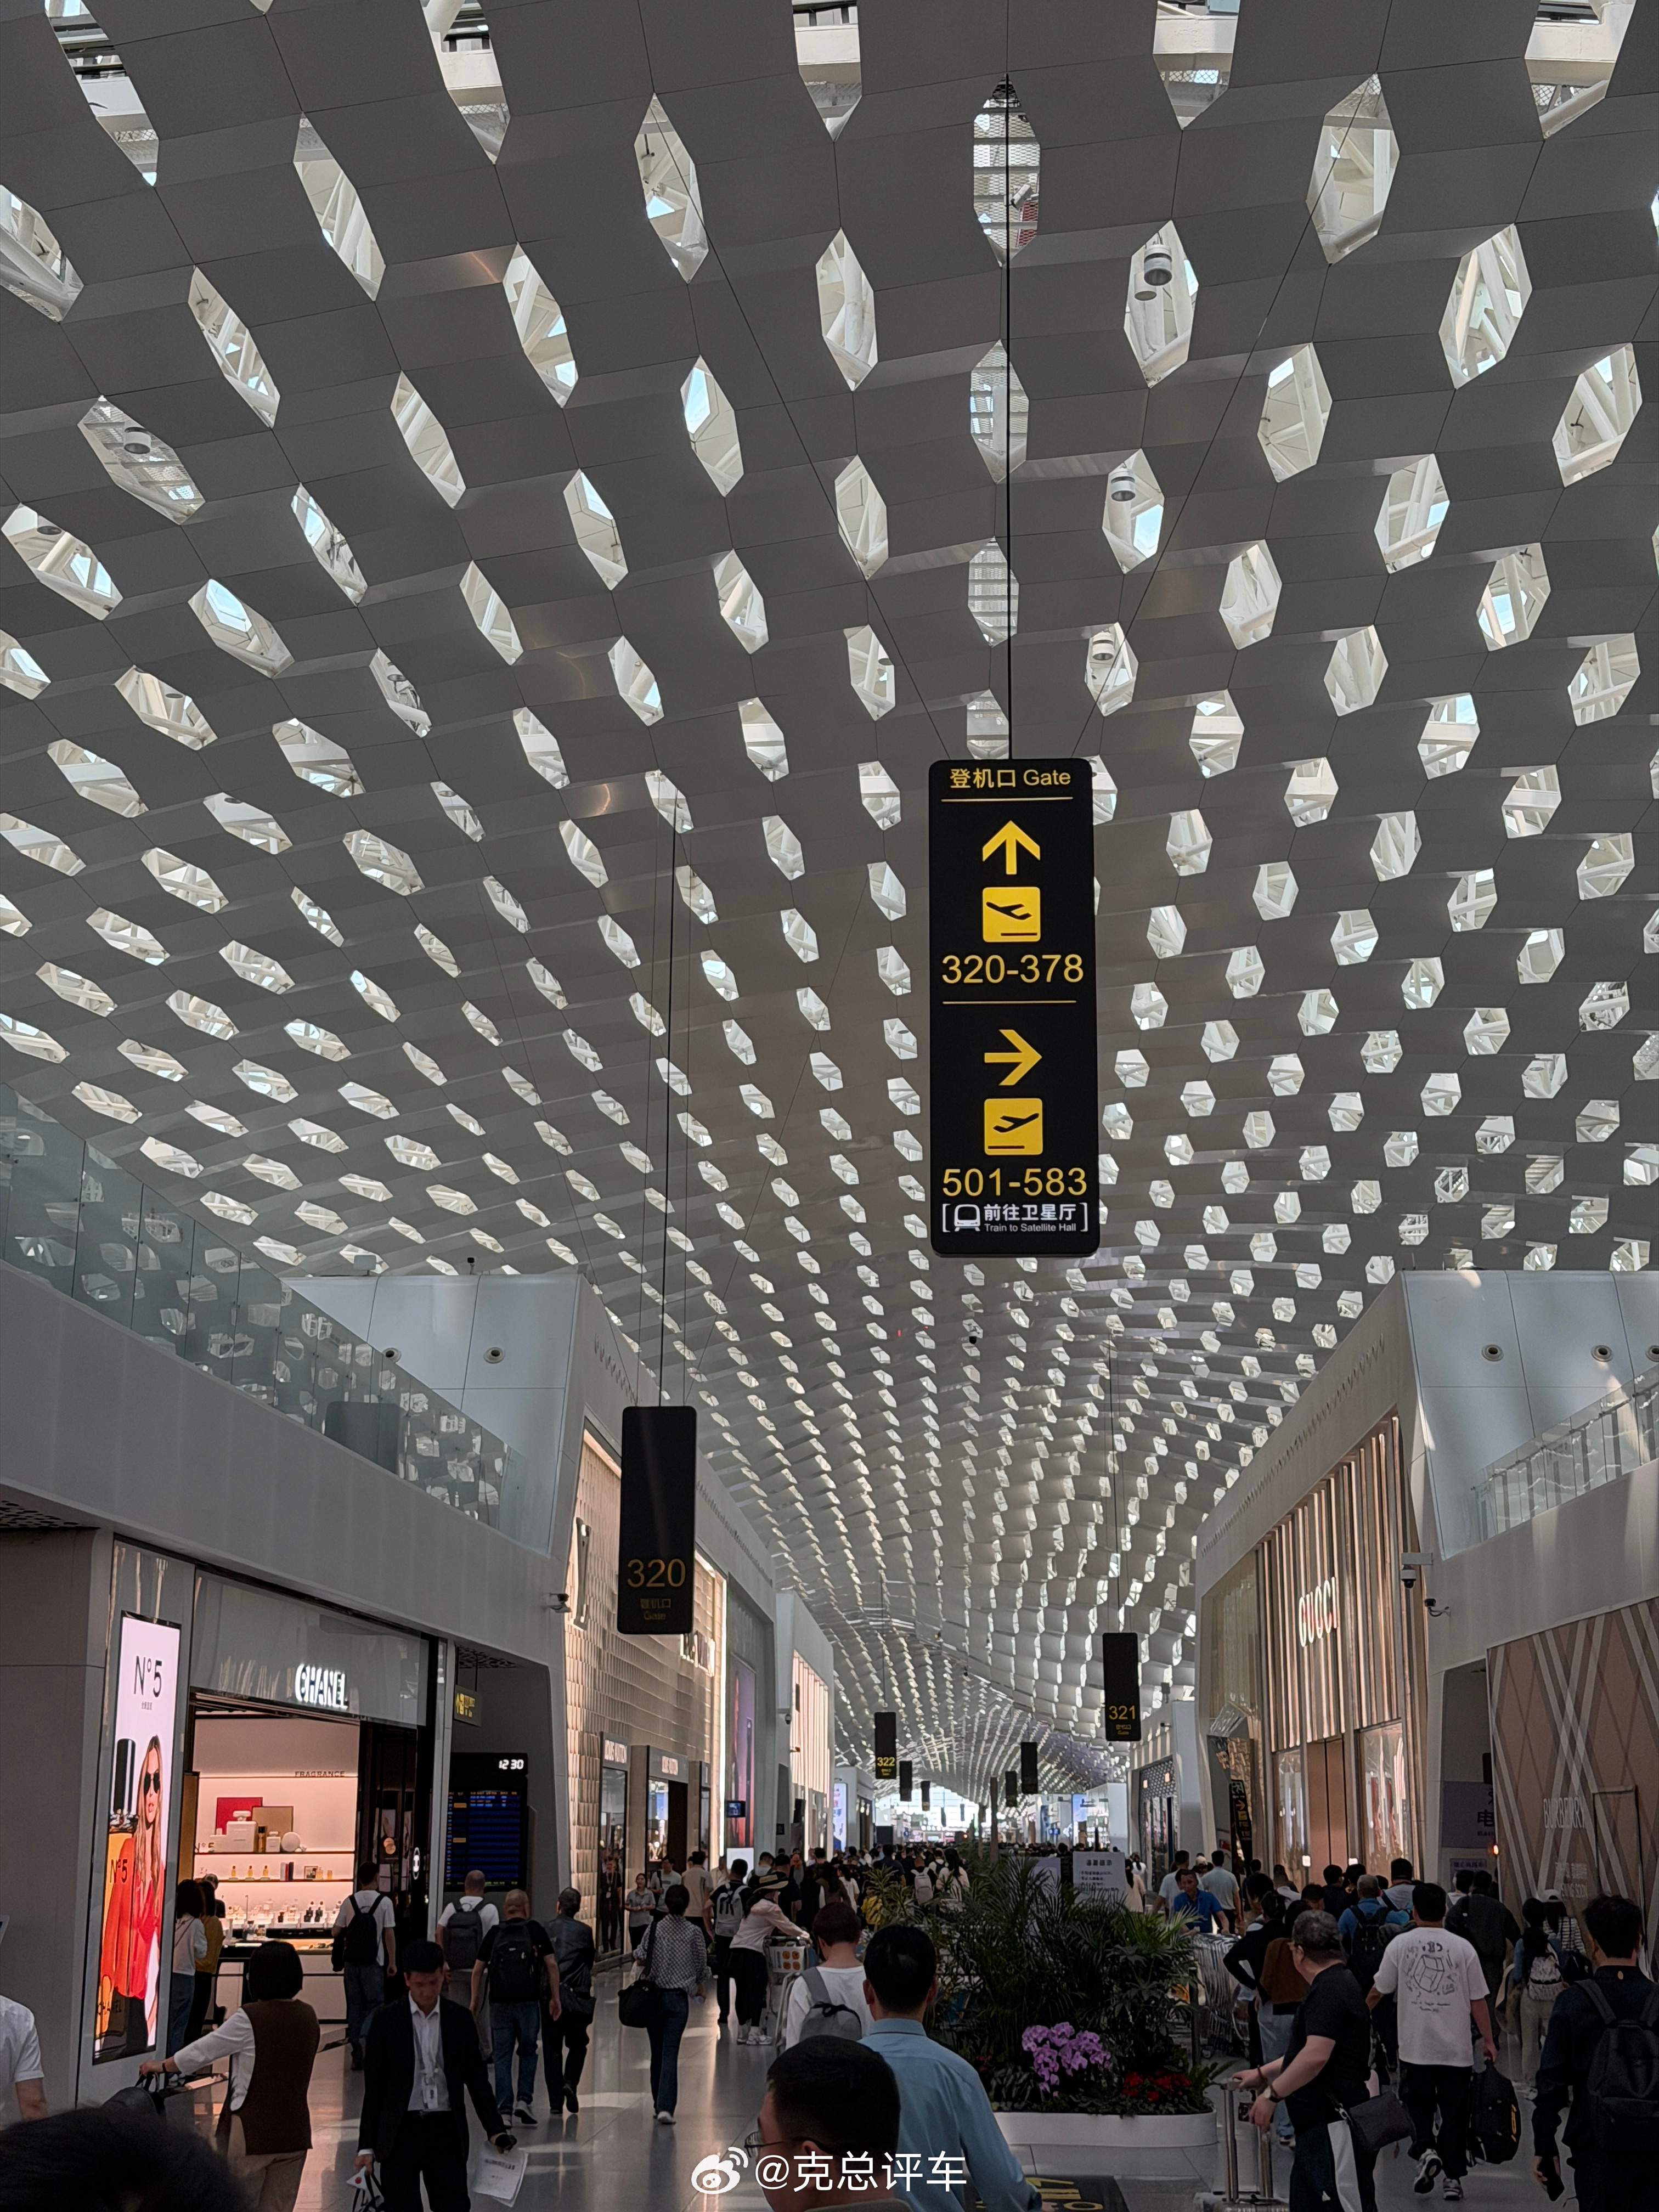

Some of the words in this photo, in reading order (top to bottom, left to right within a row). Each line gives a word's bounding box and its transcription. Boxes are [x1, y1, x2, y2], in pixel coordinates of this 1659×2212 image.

[950, 768, 1016, 788] 登机口
[1023, 769, 1071, 786] Gate
[942, 954, 1084, 984] 320-378
[943, 1167, 1087, 1197] 501-583
[984, 1204, 1076, 1221] 前往卫星厅
[984, 1223, 1007, 1232] Train
[1020, 1223, 1056, 1232] Satellite
[1059, 1223, 1076, 1232] Hall
[627, 1559, 686, 1588] 320
[1299, 1576, 1337, 1647] GUCCI
[295, 1663, 348, 1710] CHANEL
[1109, 1705, 1136, 1720] 321
[877, 1757, 895, 1767] 322
[1543, 1796, 1585, 1829] BURBERRY
